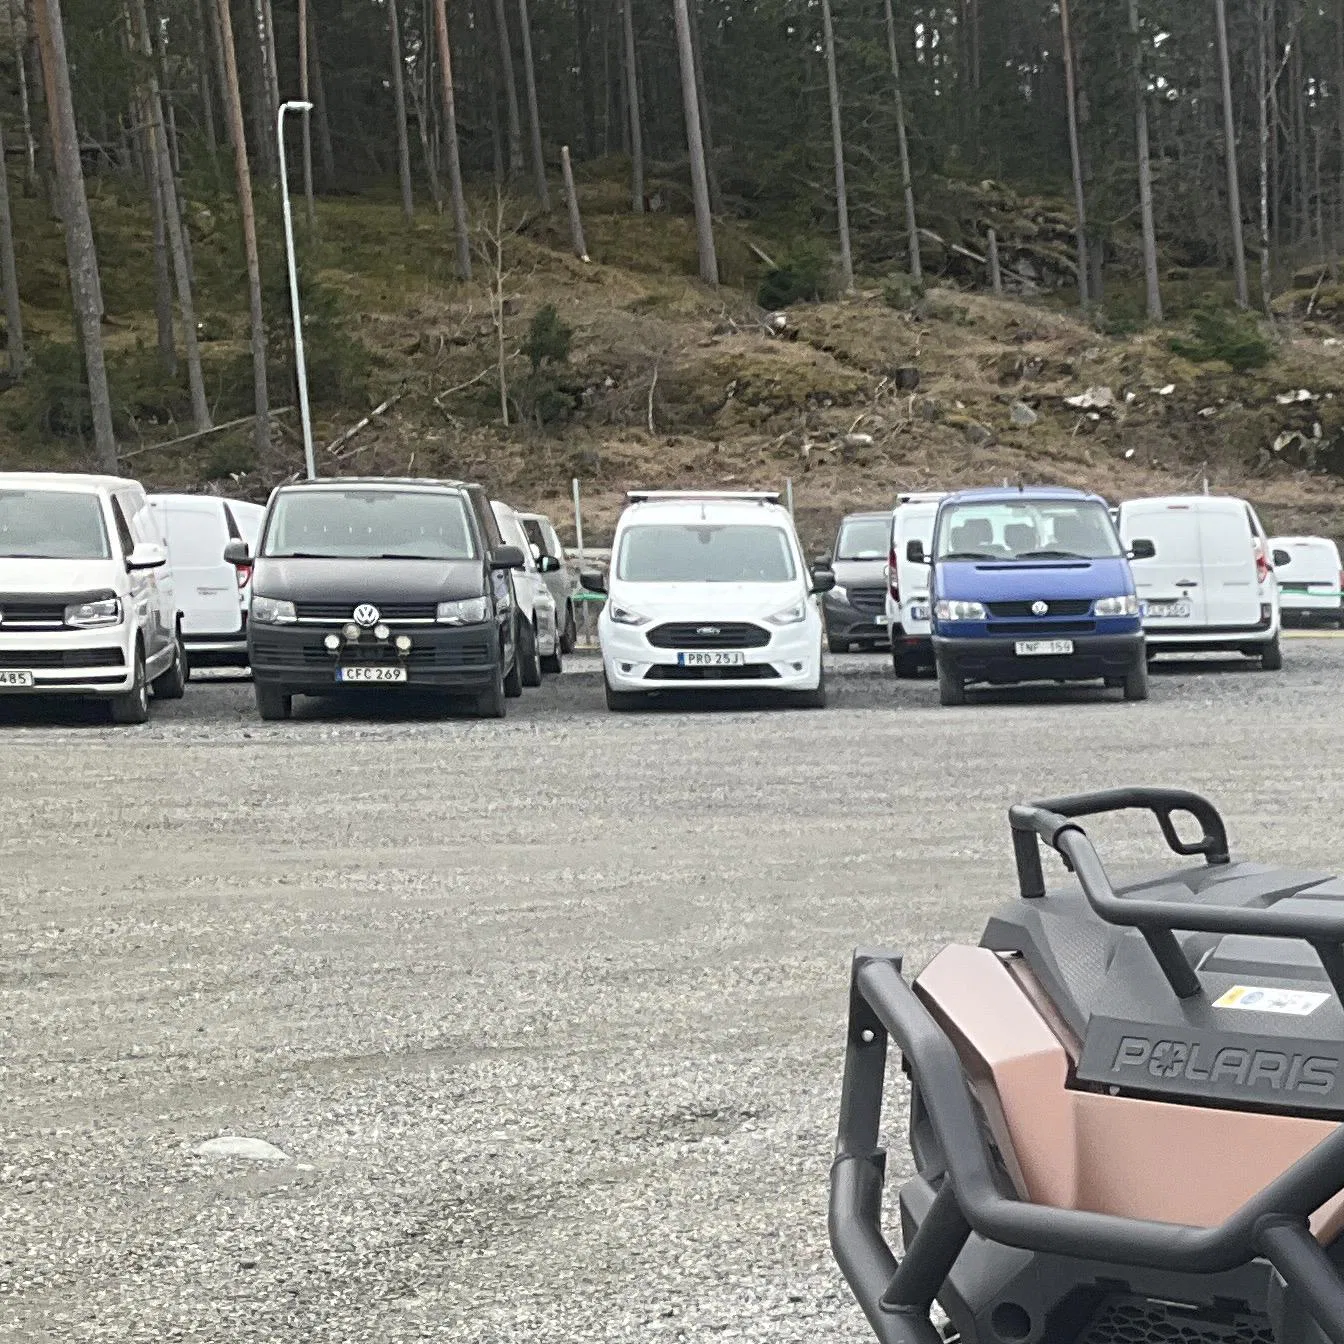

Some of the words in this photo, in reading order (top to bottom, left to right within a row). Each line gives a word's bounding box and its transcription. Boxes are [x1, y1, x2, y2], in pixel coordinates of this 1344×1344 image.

[346, 668, 372, 680] CFC
[375, 668, 401, 680] 269
[1111, 1036, 1340, 1095] POLARIS
